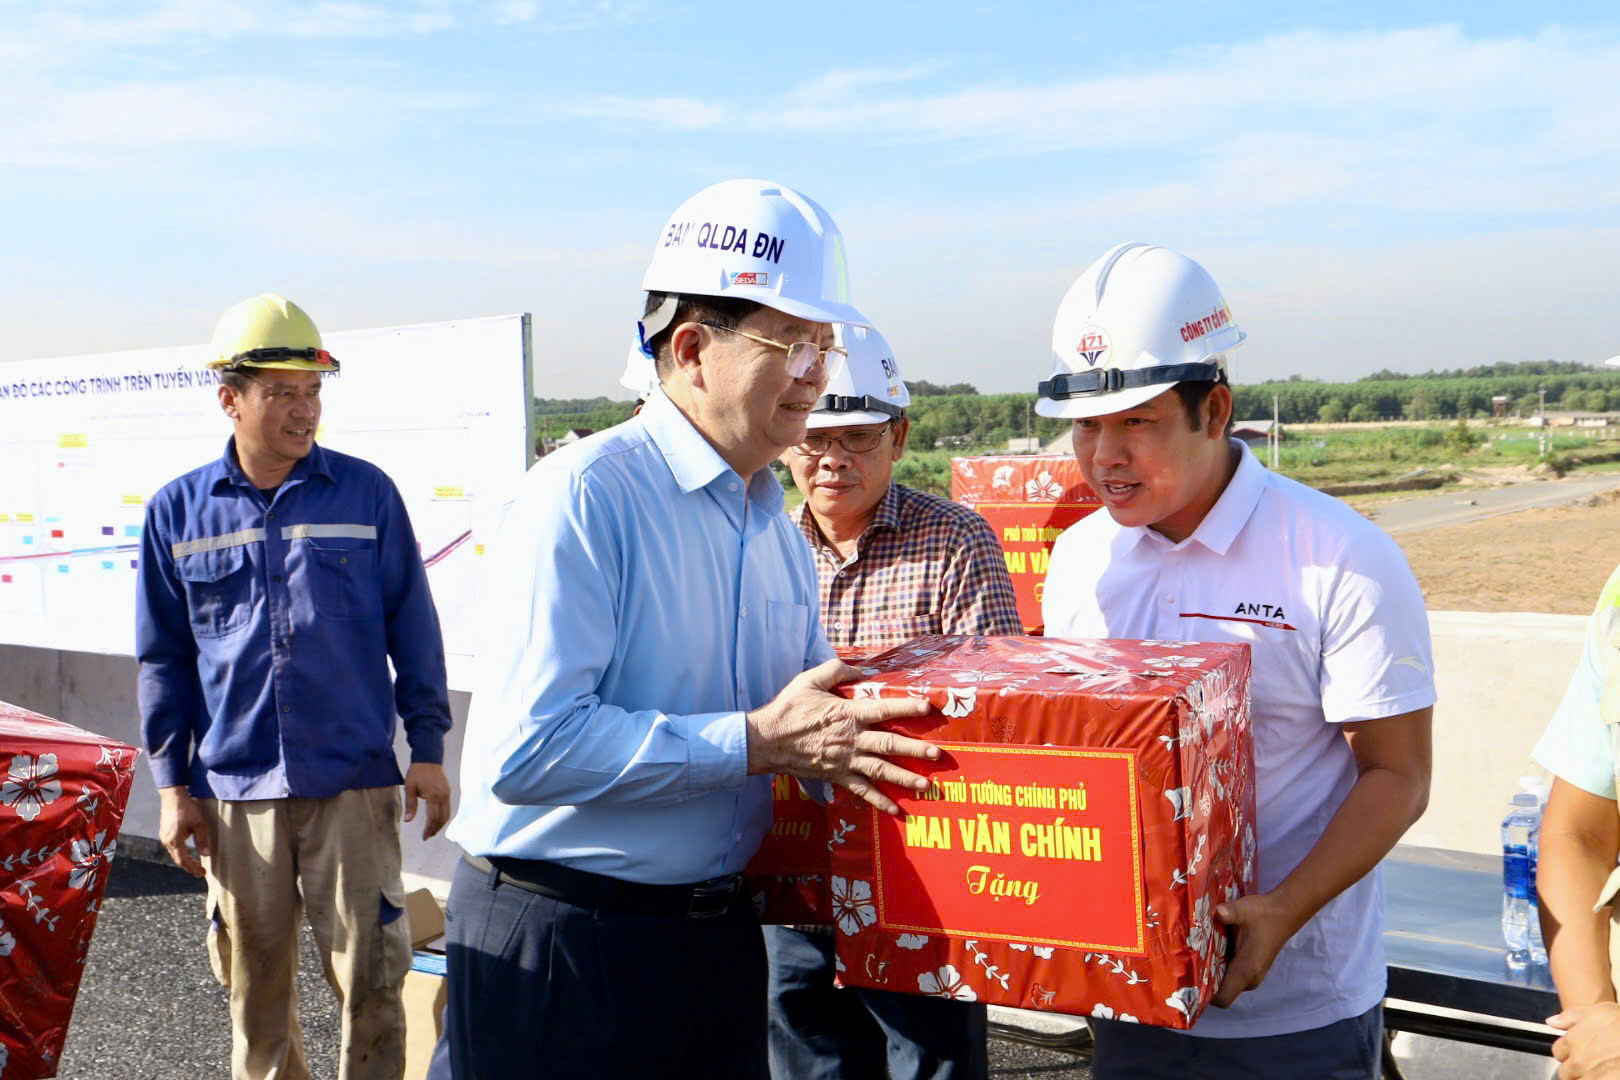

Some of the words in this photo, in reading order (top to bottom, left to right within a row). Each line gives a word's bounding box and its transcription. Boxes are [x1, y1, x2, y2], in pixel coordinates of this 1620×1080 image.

[698, 222, 747, 254] QLDA
[752, 232, 784, 264] ĐN
[1180, 322, 1205, 342] CÔNG
[1202, 316, 1213, 333] TY
[55, 376, 87, 395] CÔNG
[124, 371, 152, 391] TRÊN
[1234, 602, 1285, 620] ANTA
[943, 776, 967, 803] THỦ
[970, 780, 1012, 806] TƯỚNG
[1015, 782, 1056, 809] CHÍNH
[1059, 782, 1087, 811] PHỦ
[906, 815, 952, 849] MAI
[958, 813, 1011, 855] VĂN
[1020, 817, 1102, 862] CHÍNH
[966, 865, 1041, 905] Tặng
